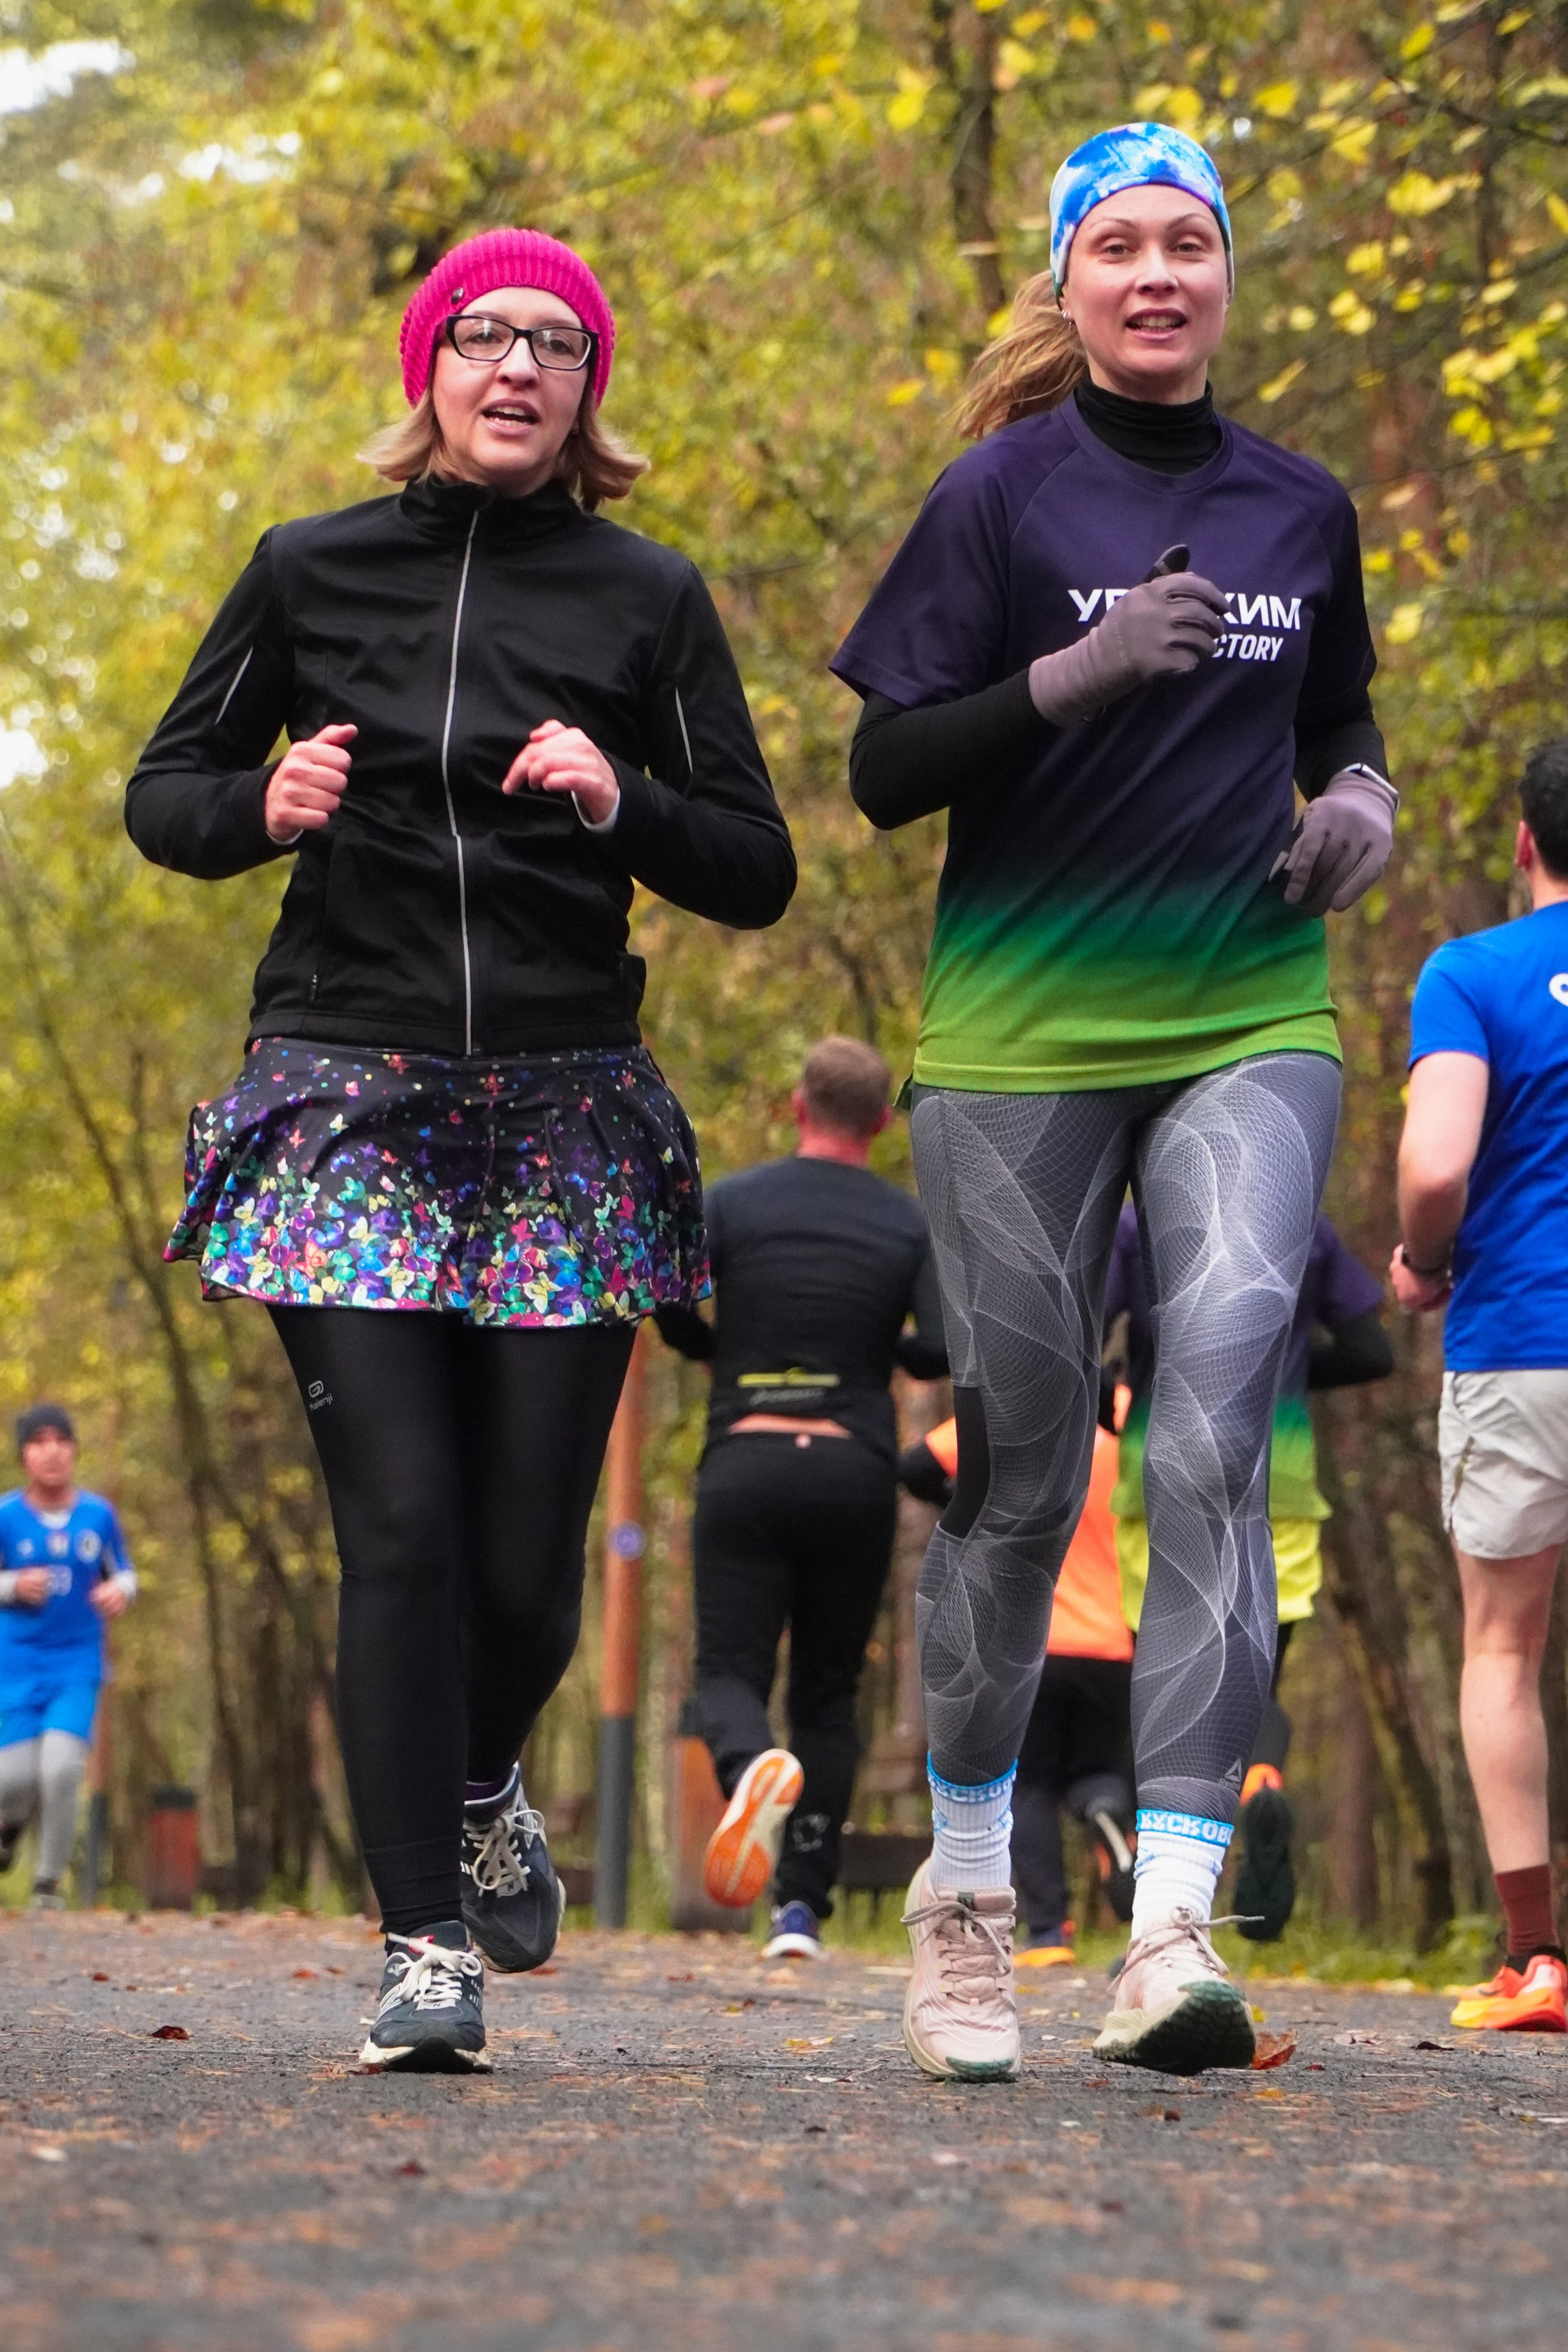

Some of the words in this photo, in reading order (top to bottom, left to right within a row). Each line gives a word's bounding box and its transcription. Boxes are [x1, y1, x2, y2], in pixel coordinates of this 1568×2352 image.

[1068, 589, 1302, 630] УРХИМ
[1212, 633, 1284, 662] CTORY
[1140, 1811, 1231, 1845] КУСКОВ
